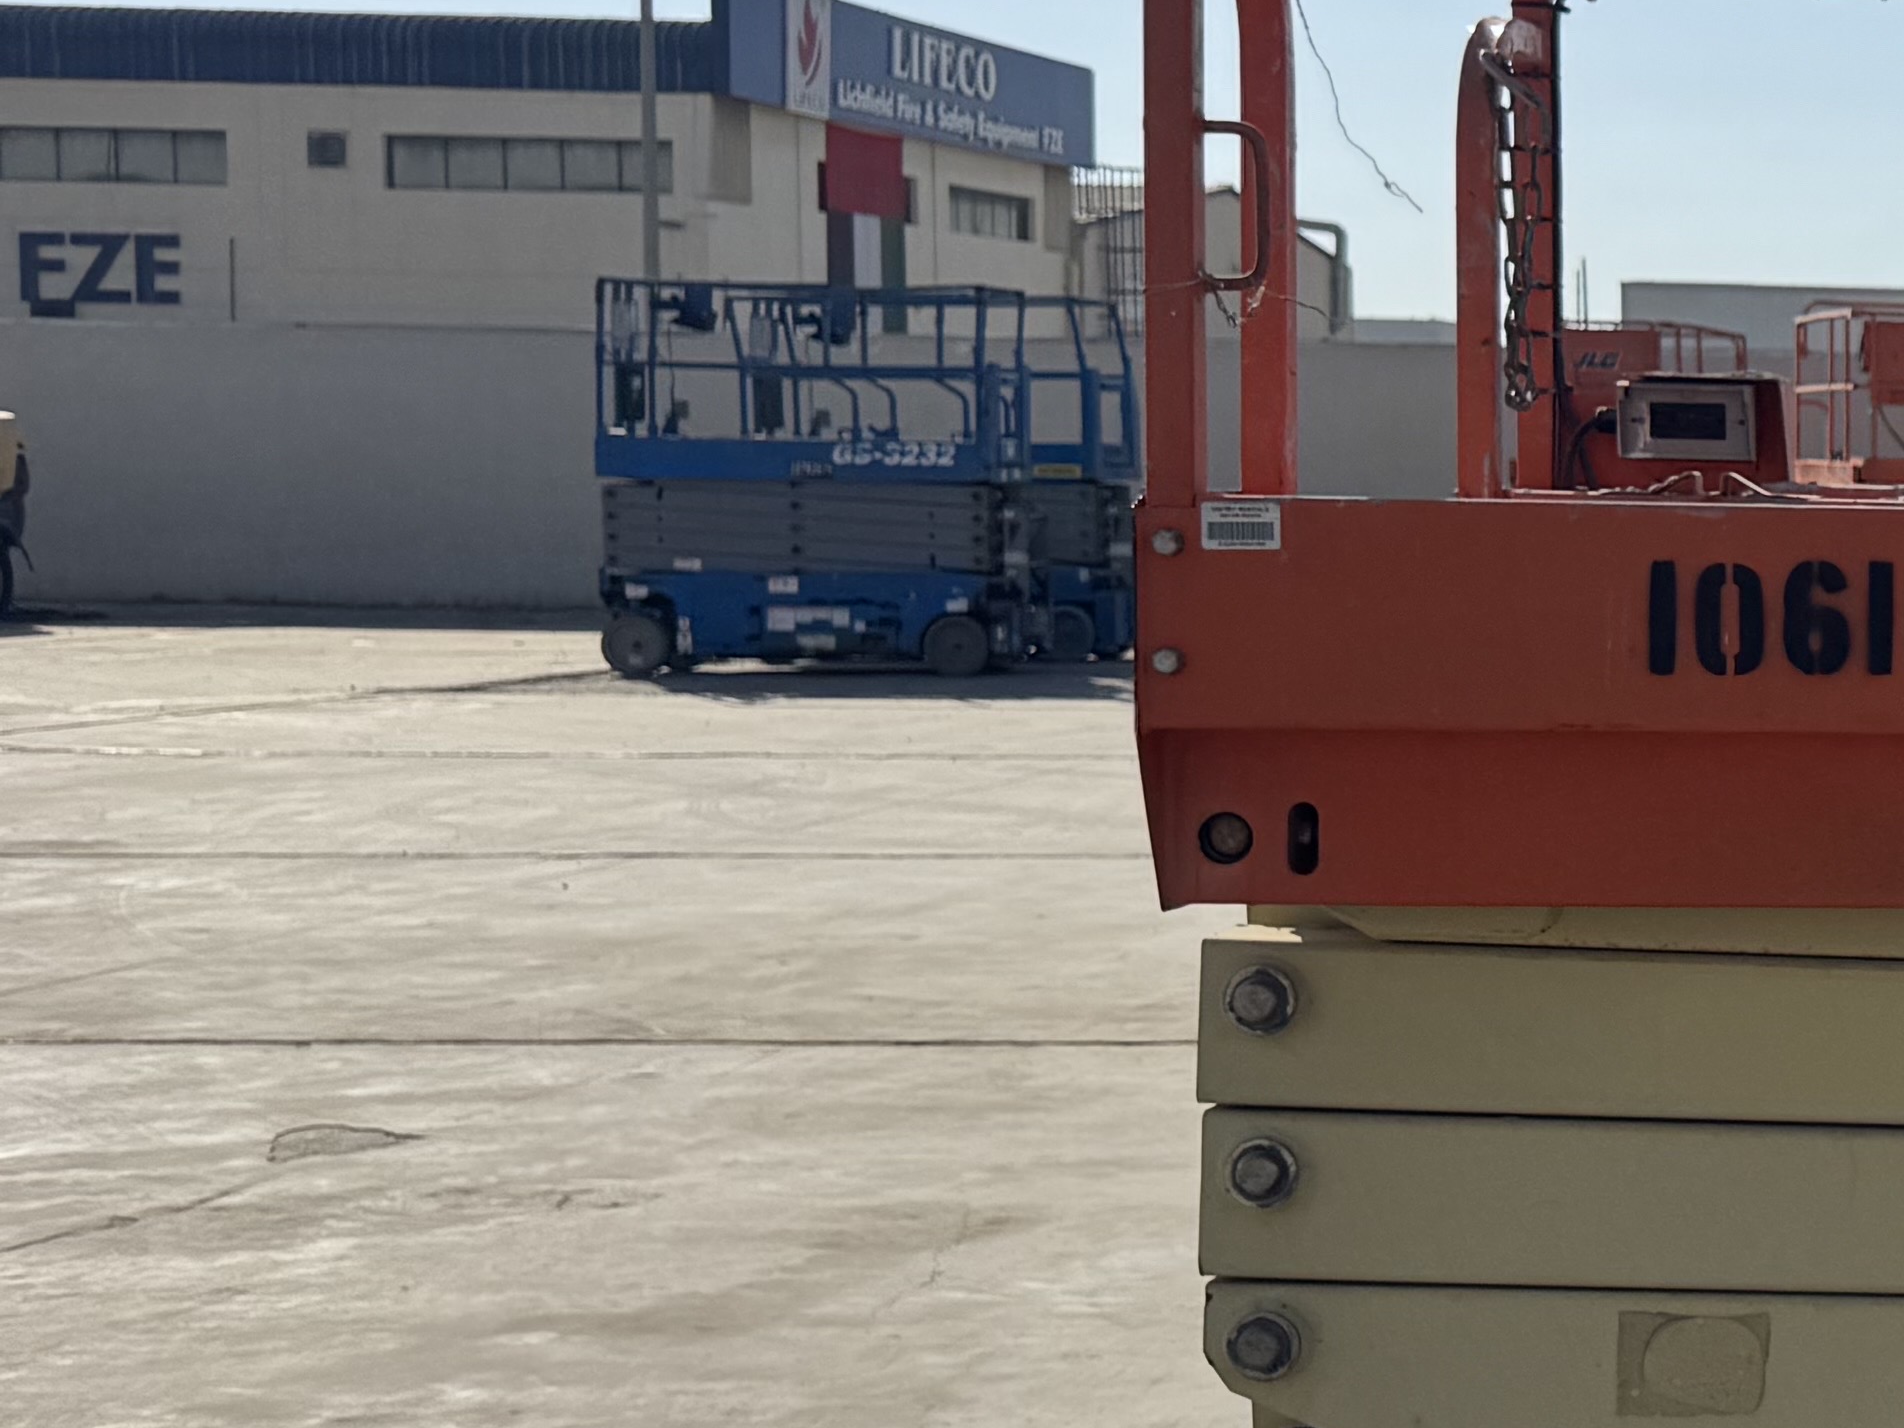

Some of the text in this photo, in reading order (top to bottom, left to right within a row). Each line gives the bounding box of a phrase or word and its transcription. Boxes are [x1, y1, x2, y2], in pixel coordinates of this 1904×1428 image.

[889, 24, 997, 102] LIFECO
[897, 91, 921, 126] Fire
[925, 99, 935, 127] &
[938, 100, 975, 142] Safety
[832, 441, 956, 468] GS-3232
